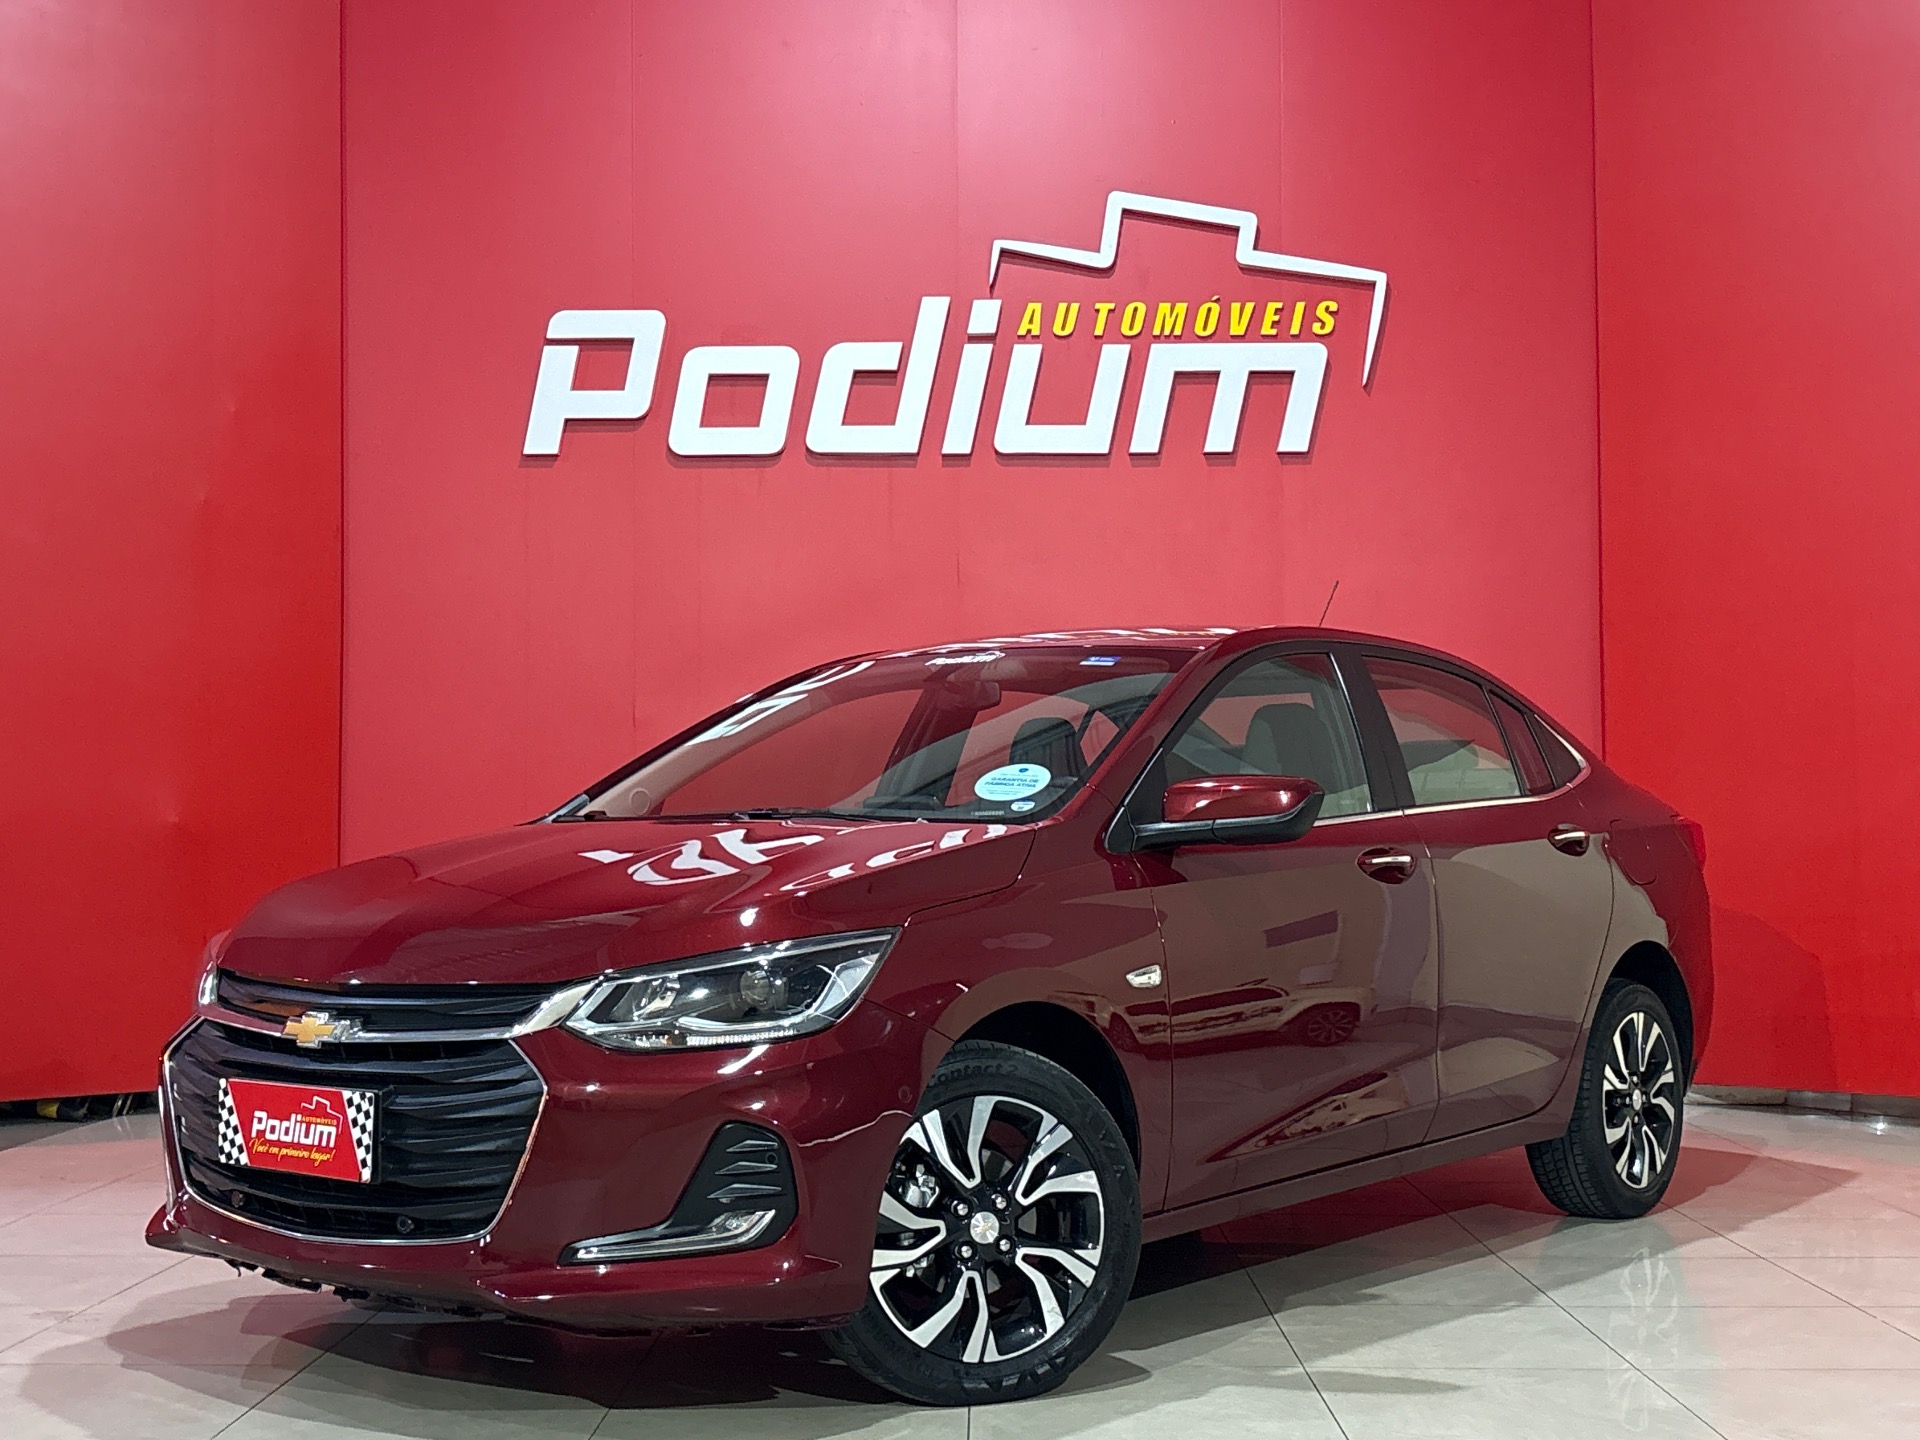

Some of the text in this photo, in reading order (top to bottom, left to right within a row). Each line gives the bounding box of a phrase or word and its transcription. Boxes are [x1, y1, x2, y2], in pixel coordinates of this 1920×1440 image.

[1017, 296, 1341, 338] AUTOMÓVEIS
[522, 296, 1329, 456] Podium
[251, 1110, 337, 1148] Podium
[249, 1138, 269, 1155] Você
[269, 1146, 279, 1154] em
[309, 1147, 336, 1167] lugar!
